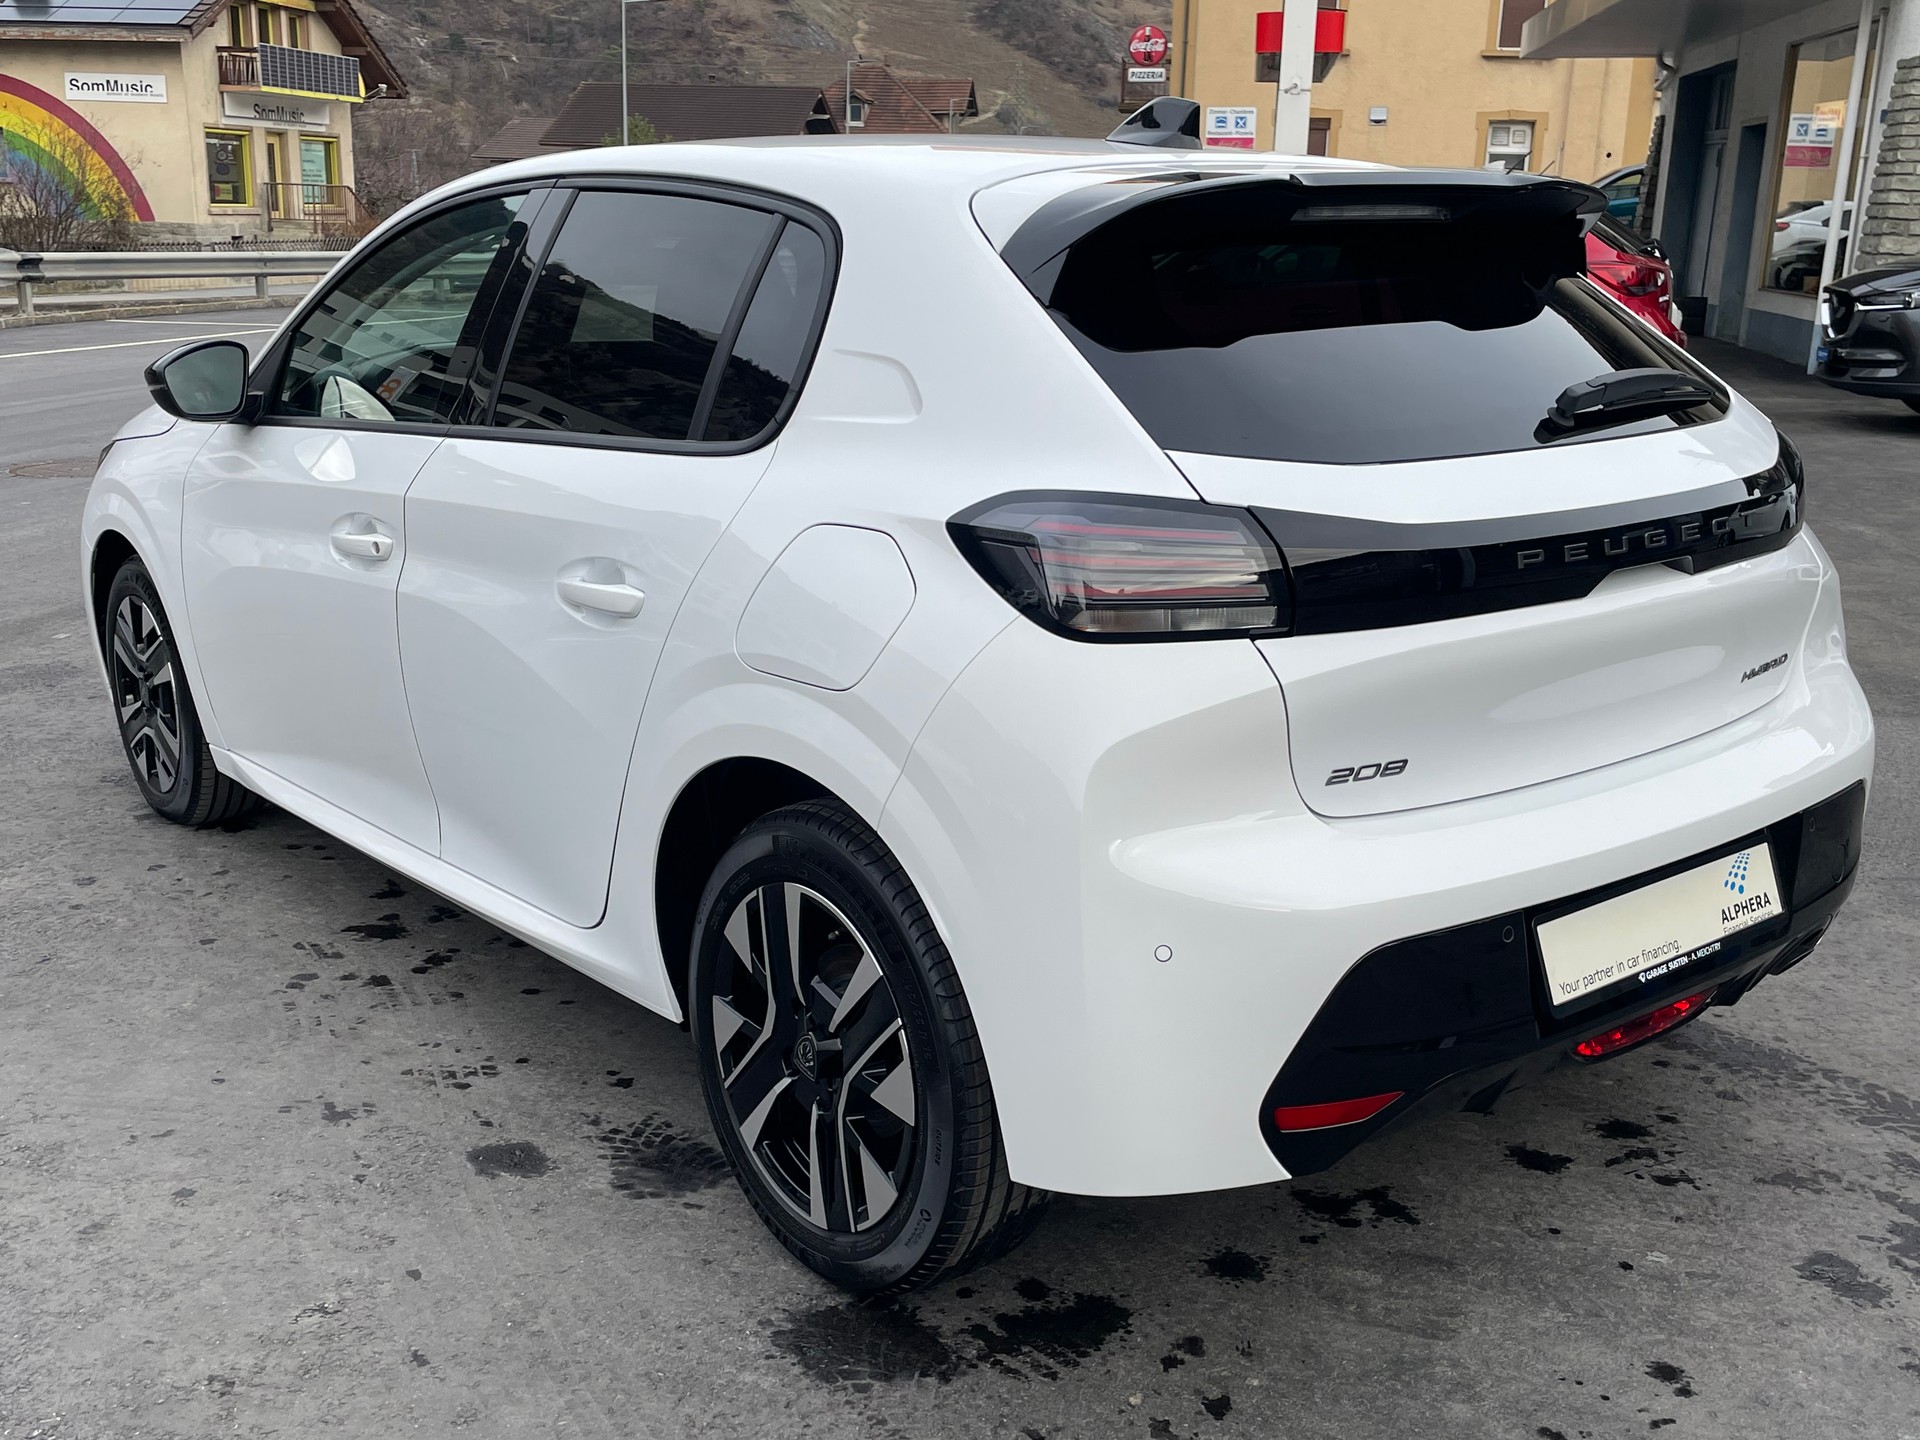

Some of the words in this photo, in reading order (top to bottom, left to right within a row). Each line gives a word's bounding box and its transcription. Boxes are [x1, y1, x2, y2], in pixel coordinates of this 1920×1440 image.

[69, 78, 154, 93] SomMusic
[1130, 71, 1164, 79] PIZZERIA
[253, 103, 305, 123] SomMusic
[1517, 514, 1751, 570] PEUGEOT
[1741, 653, 1788, 683] HYBRID
[1325, 758, 1409, 787] 208
[1721, 891, 1771, 925] ALPHERA
[1559, 979, 1581, 996] Your
[1582, 964, 1614, 990] partner
[1616, 960, 1626, 974] in
[1627, 955, 1640, 969] car
[1641, 940, 1682, 964] financing.
[1646, 964, 1669, 980] GARAGE
[1668, 955, 1689, 971] SUSTEN
